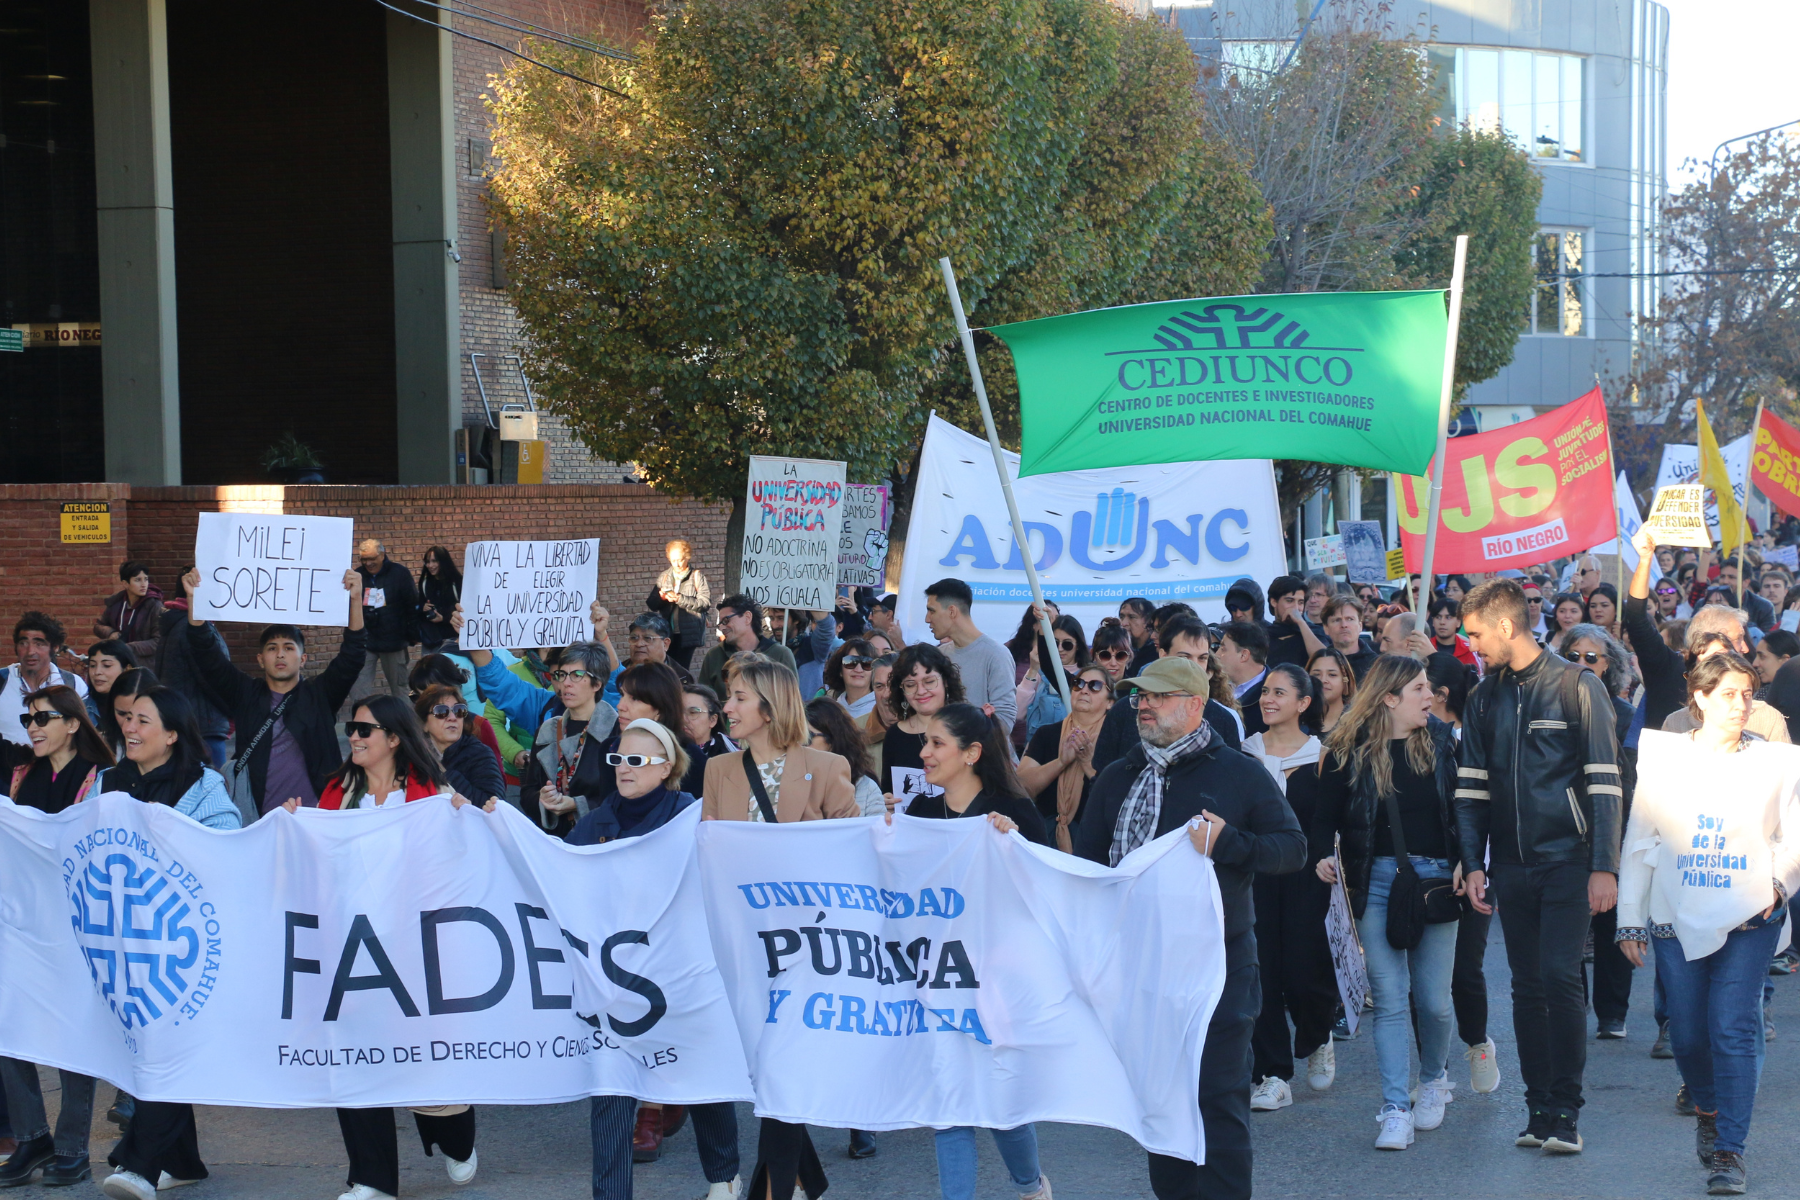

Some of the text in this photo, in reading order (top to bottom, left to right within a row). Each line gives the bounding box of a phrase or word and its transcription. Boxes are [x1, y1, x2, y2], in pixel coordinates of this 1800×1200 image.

[22, 327, 101, 341] iario RÍO NEG
[1118, 355, 1353, 391] CEDIUNCO
[1098, 390, 1374, 414] CENTRO DE DOCENTES E INVESTIGADORES
[1098, 409, 1372, 434] UNIVERSIDAD NACIONAL DEL COMAHUE
[1575, 449, 1589, 462] EL
[1756, 427, 1800, 474] PART
[784, 463, 797, 478] LA
[1754, 451, 1800, 497] OBR
[752, 480, 842, 508] UNIVERSIDAD
[844, 487, 876, 503] RTES
[63, 503, 107, 512] ATENCION
[761, 503, 825, 531] PÚBLICA
[939, 488, 1249, 572] ADUNC
[1487, 525, 1564, 557] RÍO NEGRO
[516, 543, 534, 568] LA
[744, 533, 827, 562] NO ADOCTRINA
[494, 572, 509, 588] DE
[741, 557, 758, 579] NO
[759, 560, 771, 582] ES
[209, 567, 331, 613] SORETE
[745, 586, 770, 605] NOS
[970, 580, 1233, 597] iación docetes universidad nacional del comah
[477, 595, 492, 614] LA
[517, 618, 529, 646] Y
[235, 718, 274, 772] UNDER ARMOUR
[1697, 814, 1724, 832] Soy
[74, 828, 160, 862] NACIONAL
[1692, 833, 1726, 850] de la
[166, 860, 204, 899] DEL
[1681, 869, 1732, 888] Pública
[737, 882, 966, 919] UNIVERSDAD
[180, 902, 221, 1020] COMAHUE
[757, 911, 981, 990] PÚBLICA
[765, 989, 791, 1023] Y
[393, 1045, 422, 1063] DE
[536, 1040, 549, 1058] Y
